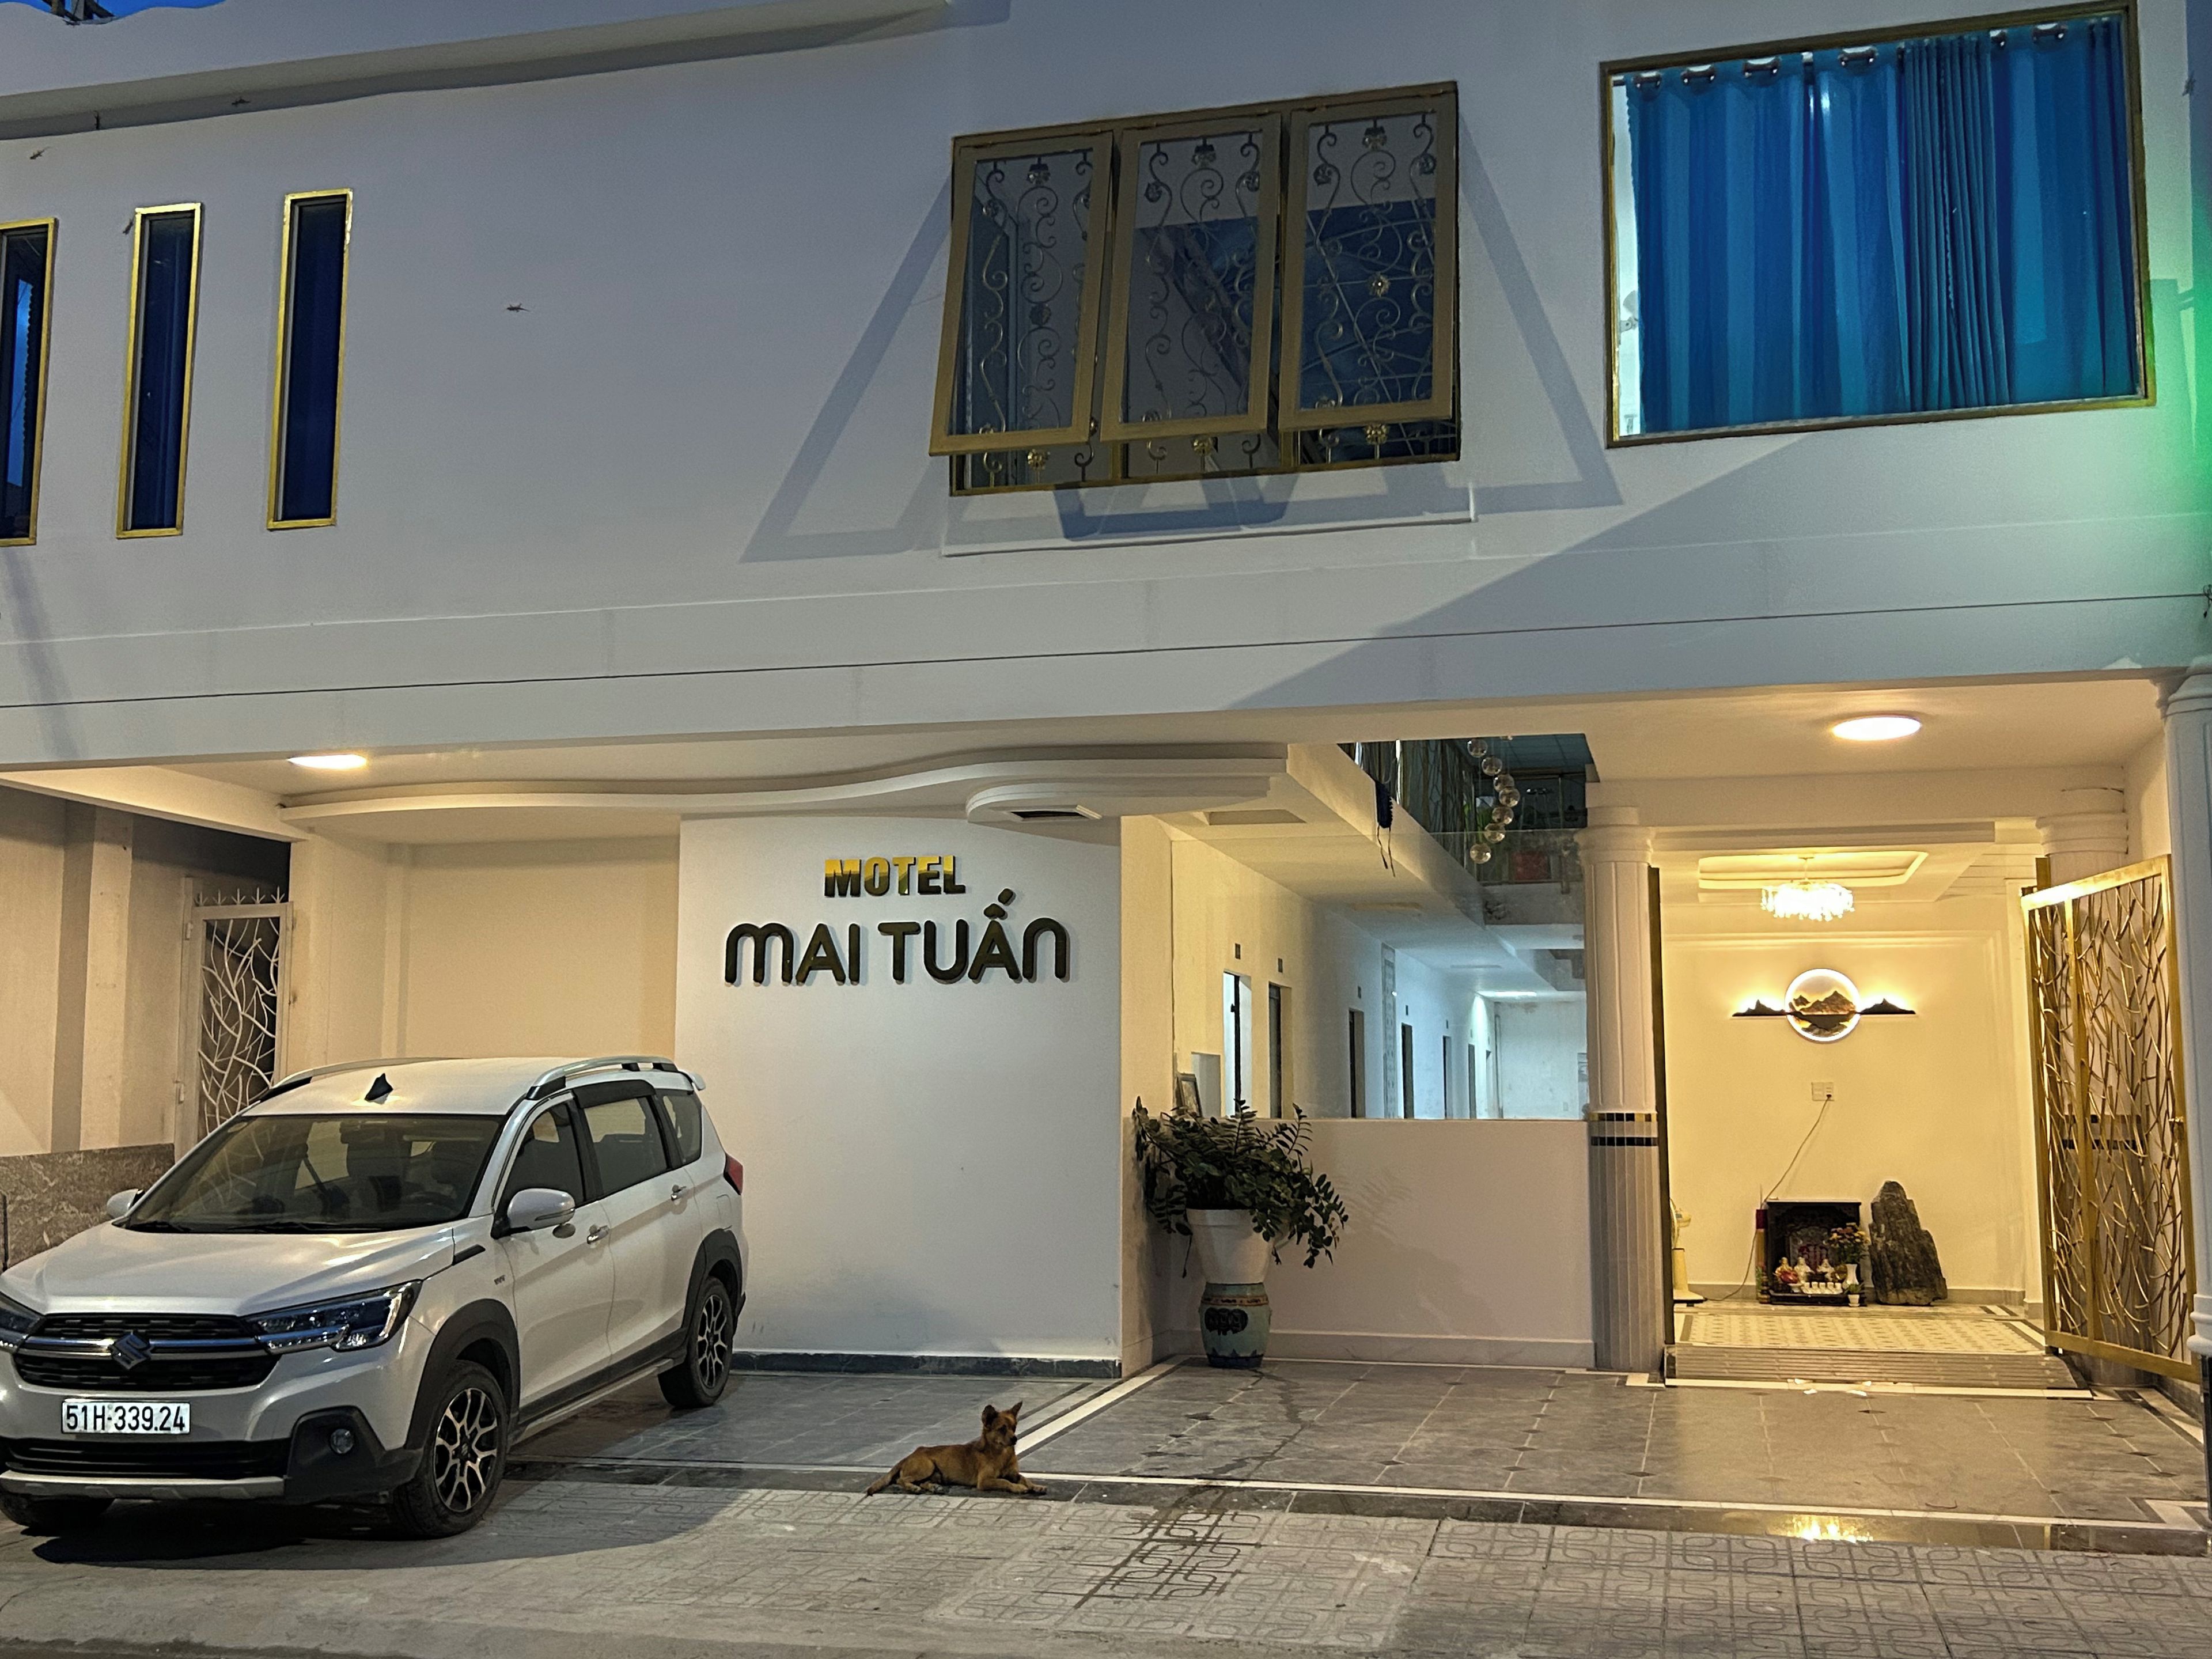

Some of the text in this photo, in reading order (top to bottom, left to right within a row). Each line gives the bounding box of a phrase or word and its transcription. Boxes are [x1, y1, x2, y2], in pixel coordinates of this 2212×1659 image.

[824, 855, 966, 897] MOTEL
[725, 923, 861, 984] MAI
[66, 1405, 185, 1431] 51H-339.24
